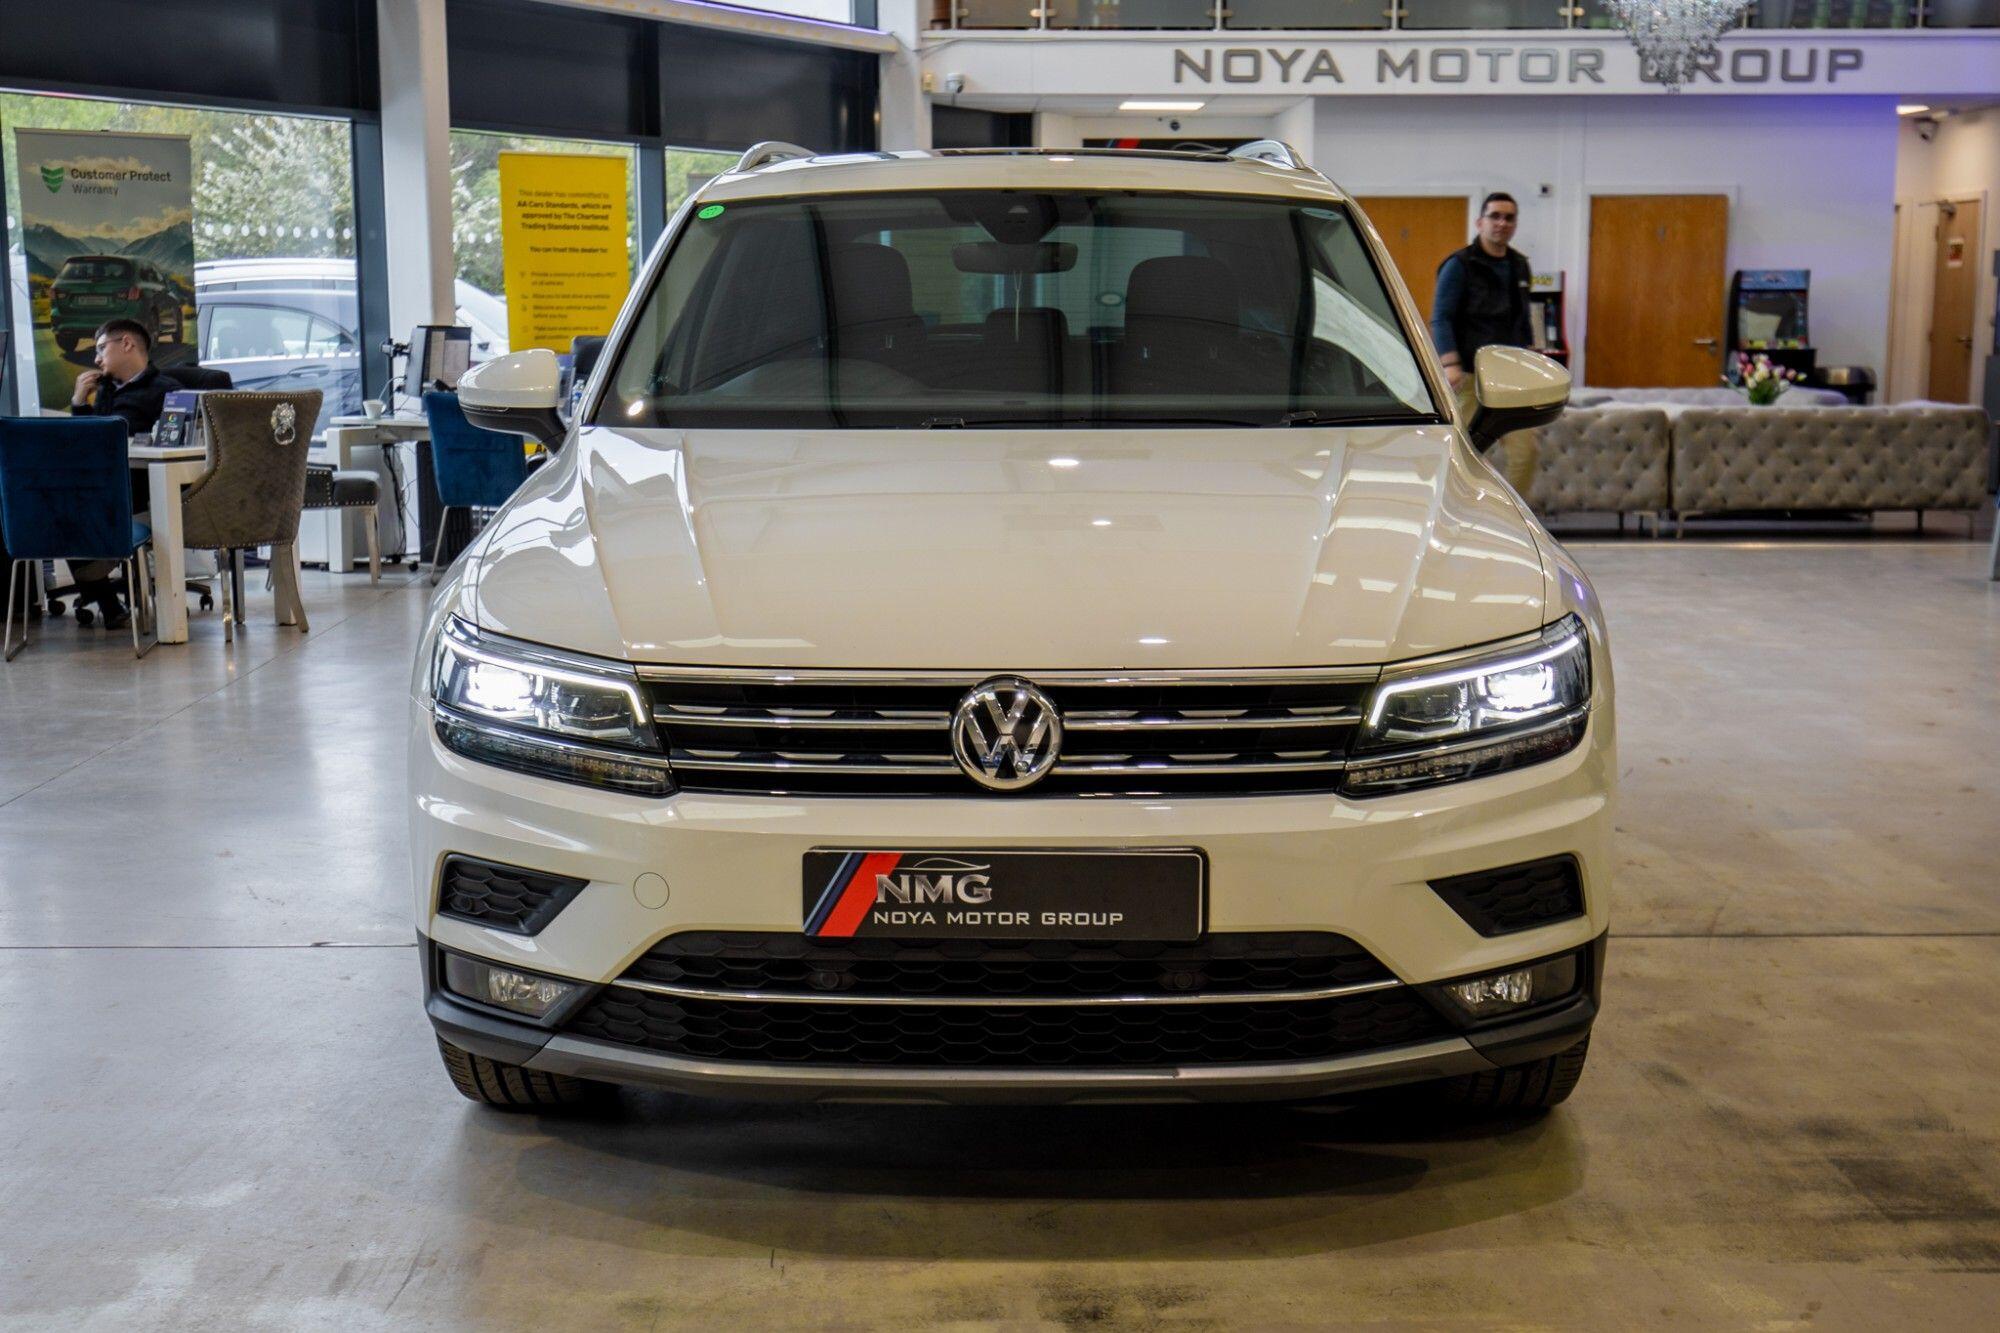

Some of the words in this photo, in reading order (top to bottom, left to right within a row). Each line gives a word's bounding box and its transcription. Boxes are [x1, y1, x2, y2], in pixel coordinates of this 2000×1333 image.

[1173, 48, 1343, 83] NOYA
[1376, 48, 1606, 83] MOTOR
[71, 168, 127, 181] Customer
[130, 170, 172, 182] Protect
[72, 184, 119, 197] Warranty
[521, 223, 546, 231] Trading
[875, 873, 992, 904] NMG
[874, 911, 936, 926] NOYA
[946, 911, 1030, 926] MOTOR
[1041, 911, 1124, 926] GROUP
